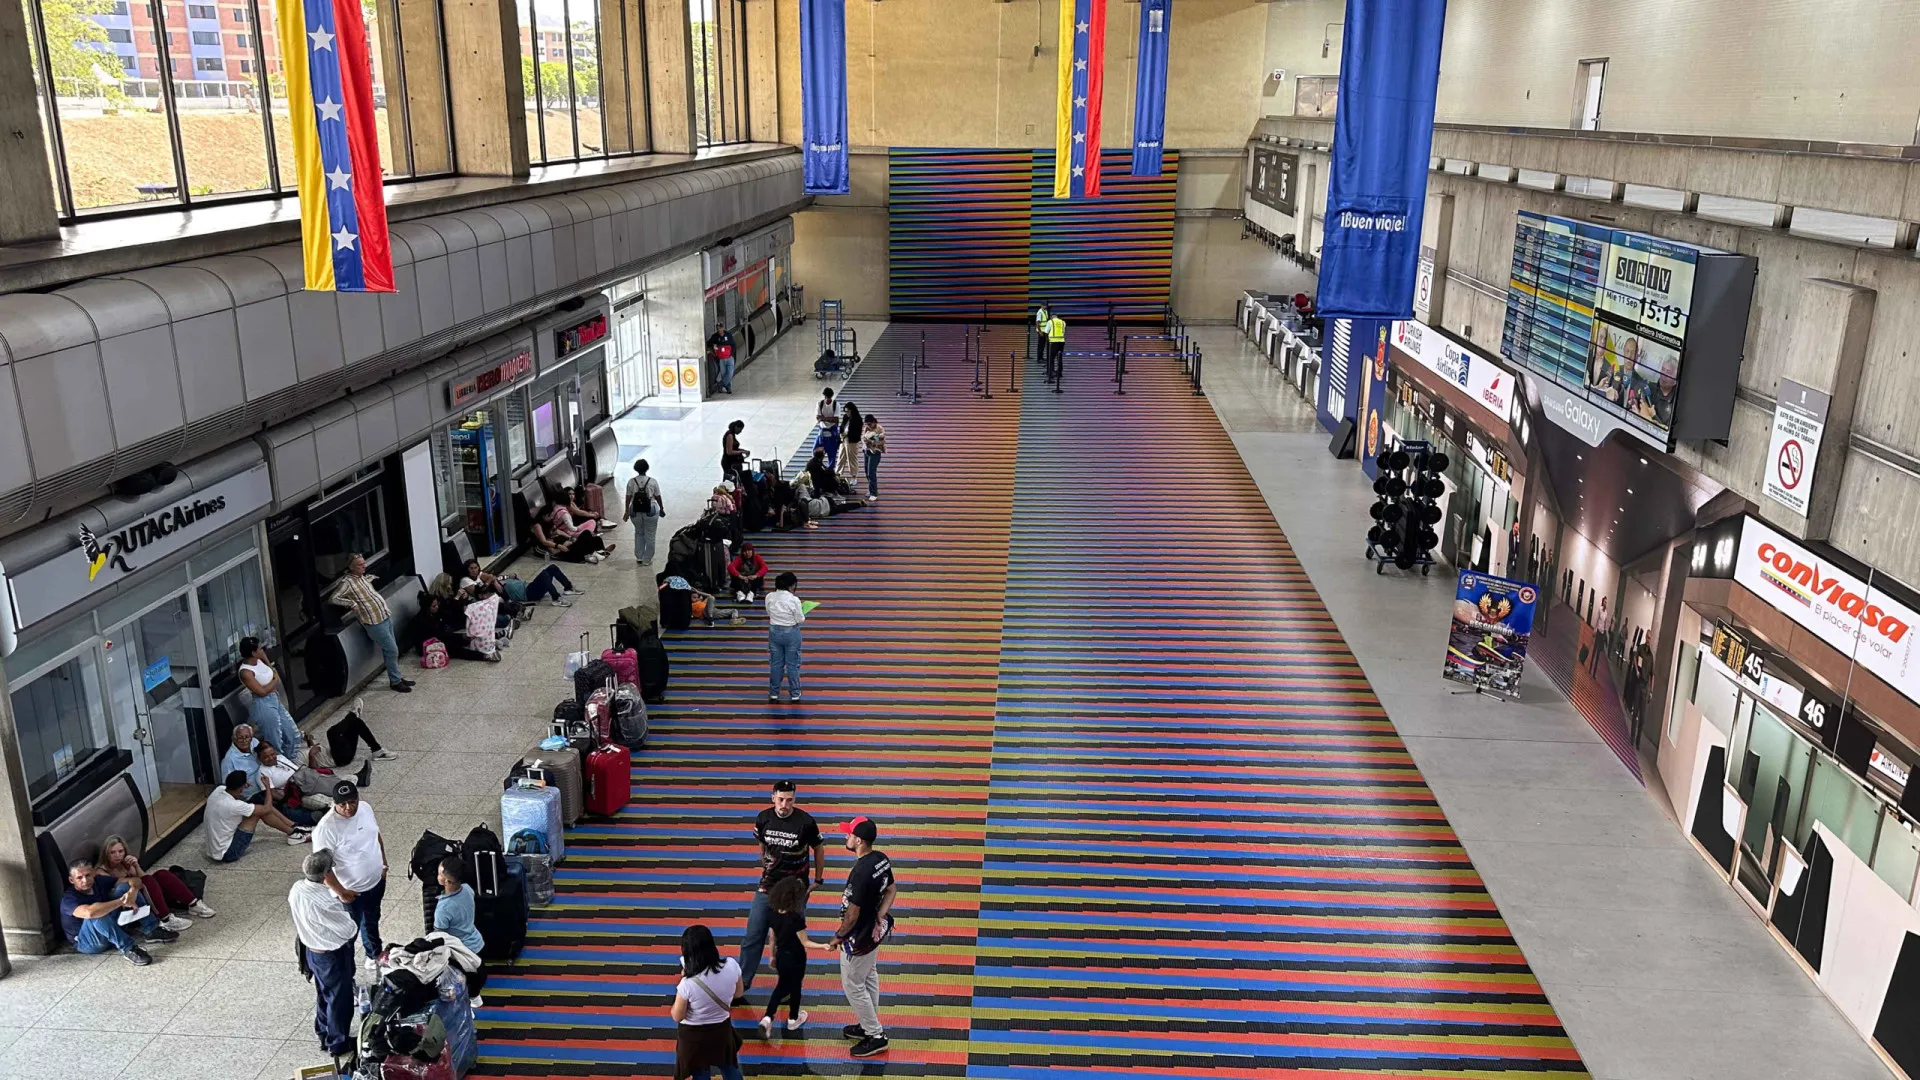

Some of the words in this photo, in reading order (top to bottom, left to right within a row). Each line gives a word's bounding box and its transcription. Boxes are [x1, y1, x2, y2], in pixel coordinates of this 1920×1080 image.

[1340, 211, 1372, 230] ¡Buen
[1375, 214, 1407, 232] viaje!
[1616, 257, 1672, 293] SINIV
[1618, 295, 1625, 304] 11
[1626, 297, 1638, 309] Sep
[1640, 297, 1682, 328] 15:13
[1405, 322, 1423, 341] TURKISH
[1404, 338, 1421, 355] AIRLINES
[1445, 344, 1460, 366] Copa
[1436, 356, 1457, 382] Airlines
[1413, 390, 1419, 402] 11
[1482, 388, 1504, 411] IBERIA
[1429, 405, 1435, 418] 12
[1543, 395, 1565, 415] SAMSUNG
[1564, 399, 1601, 440] Galaxy
[1466, 431, 1473, 446] 13
[1787, 421, 1797, 430] 100%
[1797, 426, 1809, 435] LIBRE
[1487, 447, 1493, 462] 14
[1814, 603, 1823, 615] El
[1823, 607, 1852, 635] placer
[1852, 628, 1867, 643] de
[1869, 637, 1894, 660] volar
[1744, 652, 1763, 679] 45
[1803, 698, 1825, 728] 46
[765, 829, 799, 839] SELECCIÓN
